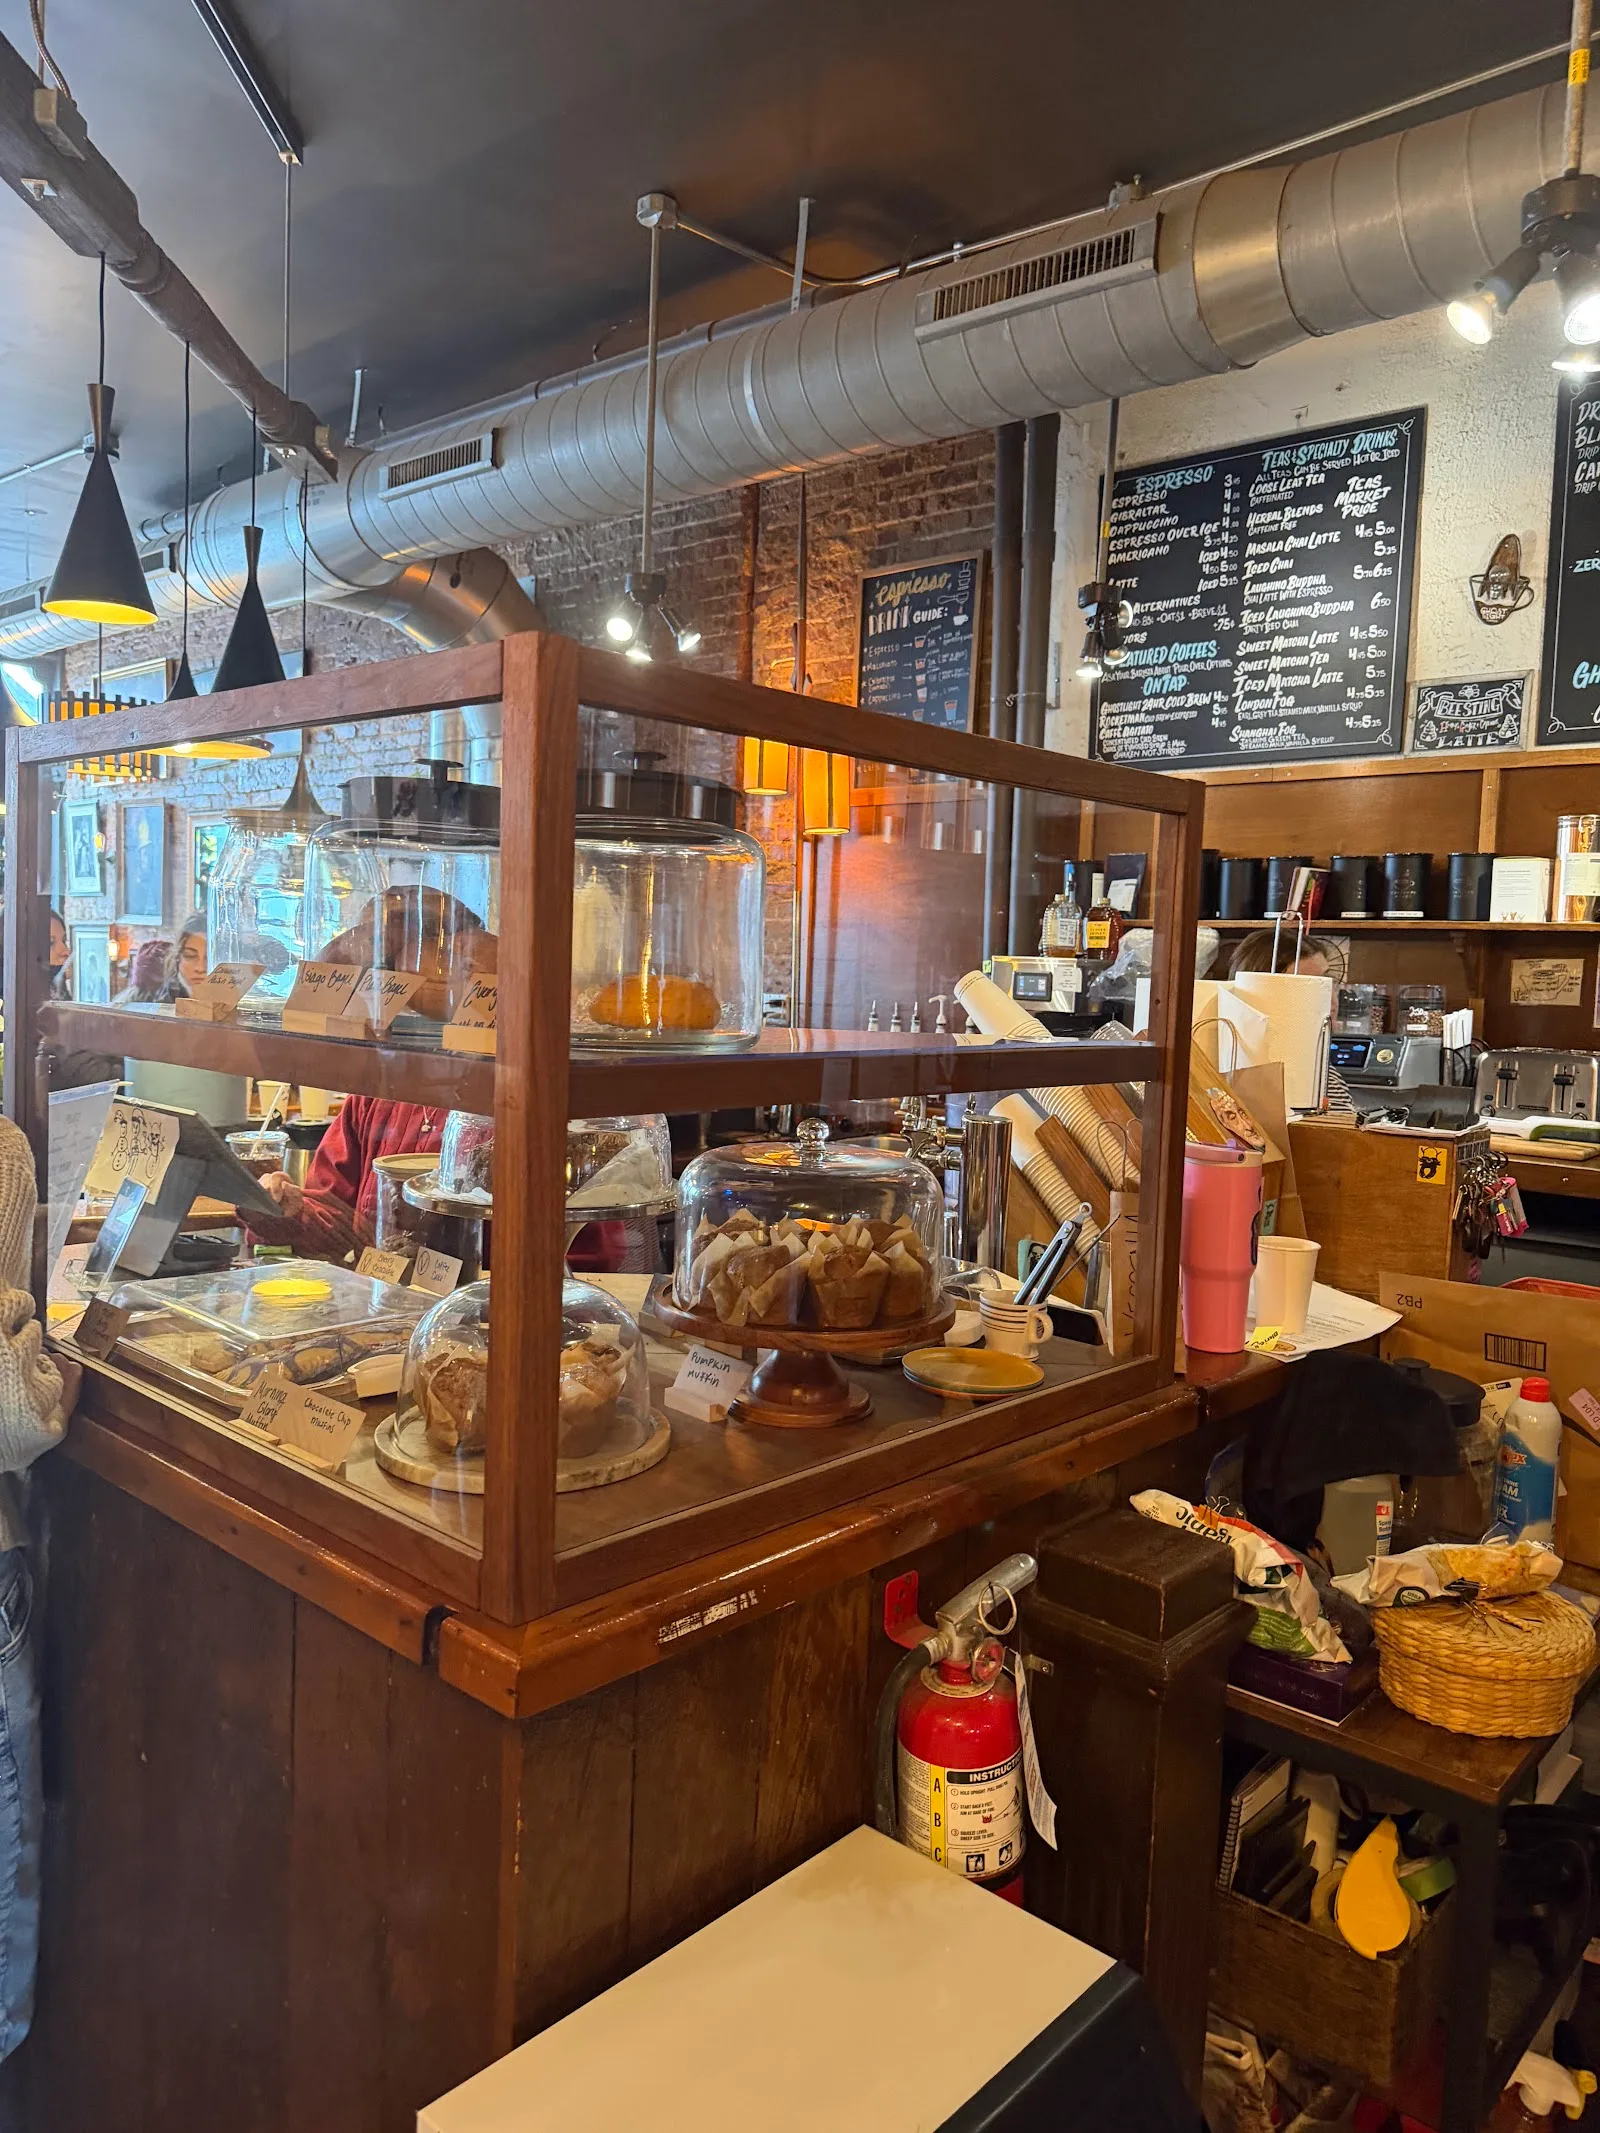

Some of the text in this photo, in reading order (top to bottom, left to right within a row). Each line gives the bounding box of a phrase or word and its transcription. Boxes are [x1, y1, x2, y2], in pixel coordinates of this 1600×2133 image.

[1262, 428, 1398, 472] TEAS SPECIALTY DRINKS
[1255, 473, 1271, 484] ALL
[1293, 466, 1309, 477] CAN
[1309, 464, 1321, 473] BE
[1321, 458, 1351, 471] SERVED
[1353, 454, 1370, 466] HOT
[1370, 452, 1382, 461] OR
[1381, 448, 1400, 461] ICED
[1136, 465, 1213, 494] ESPRESSO
[1248, 473, 1326, 497] LOOSE LEAF TEA
[1347, 475, 1383, 493] TEAS
[1112, 490, 1167, 509] ESPRESSO
[1250, 490, 1294, 507] CAFFEINATED
[1333, 486, 1392, 508] MARKET
[1110, 504, 1170, 523] GIBRALTAR
[1246, 503, 1324, 528] HERBAL BLENDS
[1341, 501, 1379, 520] PRICE
[1109, 515, 1179, 538] CAPPUCCINO
[1109, 532, 1165, 551] ESPRESSO
[1166, 526, 1199, 541] OVER
[1199, 522, 1221, 536] ICE
[1248, 520, 1298, 536] CAFFEINE FREE
[1108, 545, 1170, 566] AMERICANO
[1245, 542, 1283, 558] MASALA
[1284, 535, 1308, 552] CHAI
[1308, 531, 1341, 550] LATTE
[1199, 550, 1220, 564] ICED
[1242, 559, 1270, 580] ICED
[1269, 556, 1294, 574] CHAI
[875, 572, 951, 608] espresso
[1197, 579, 1219, 593] ICED
[1243, 585, 1333, 606] CHAI LATTE WITH ESPRESSO
[1244, 580, 1287, 596] LAUGHING
[1287, 574, 1326, 590] BUDDHA
[1133, 595, 1200, 614] ALTERNATIVES
[1239, 609, 1265, 628] ICED
[1265, 606, 1312, 622] LAUGHING
[1310, 600, 1354, 618] BUDDHA
[868, 605, 912, 637] DRINK
[1168, 640, 1217, 661] COFFEES
[1236, 640, 1271, 657] SWEET
[1271, 635, 1308, 652] MATCHA
[1308, 630, 1340, 649] LATTE
[1234, 661, 1269, 676] SWEET
[1268, 656, 1309, 672] MATCHA
[1309, 651, 1330, 667] TEA
[1143, 674, 1188, 696] ON TAP
[1232, 675, 1265, 698] ICED
[1264, 673, 1311, 692] MATCHA
[1311, 667, 1344, 688] LATTE
[1100, 700, 1142, 716] GHOSTLIGHT
[1165, 695, 1185, 710] COLD
[1185, 692, 1212, 707] BREW
[1235, 694, 1273, 713] LONDON
[1272, 691, 1295, 709] FOG
[1341, 701, 1363, 712] SYRUP
[1437, 698, 1500, 717] BEESTING
[1099, 713, 1145, 729] ROCKETMAN
[1229, 724, 1277, 743] SHANGHAI
[1277, 721, 1297, 736] FOG
[1436, 731, 1499, 748] LATTE
[1141, 749, 1157, 758] NOT
[1396, 1293, 1422, 1309] PB2
[304, 1397, 335, 1419] Chocolate
[933, 1778, 942, 1793] A
[934, 1812, 942, 1827] B
[934, 1847, 942, 1862] C
